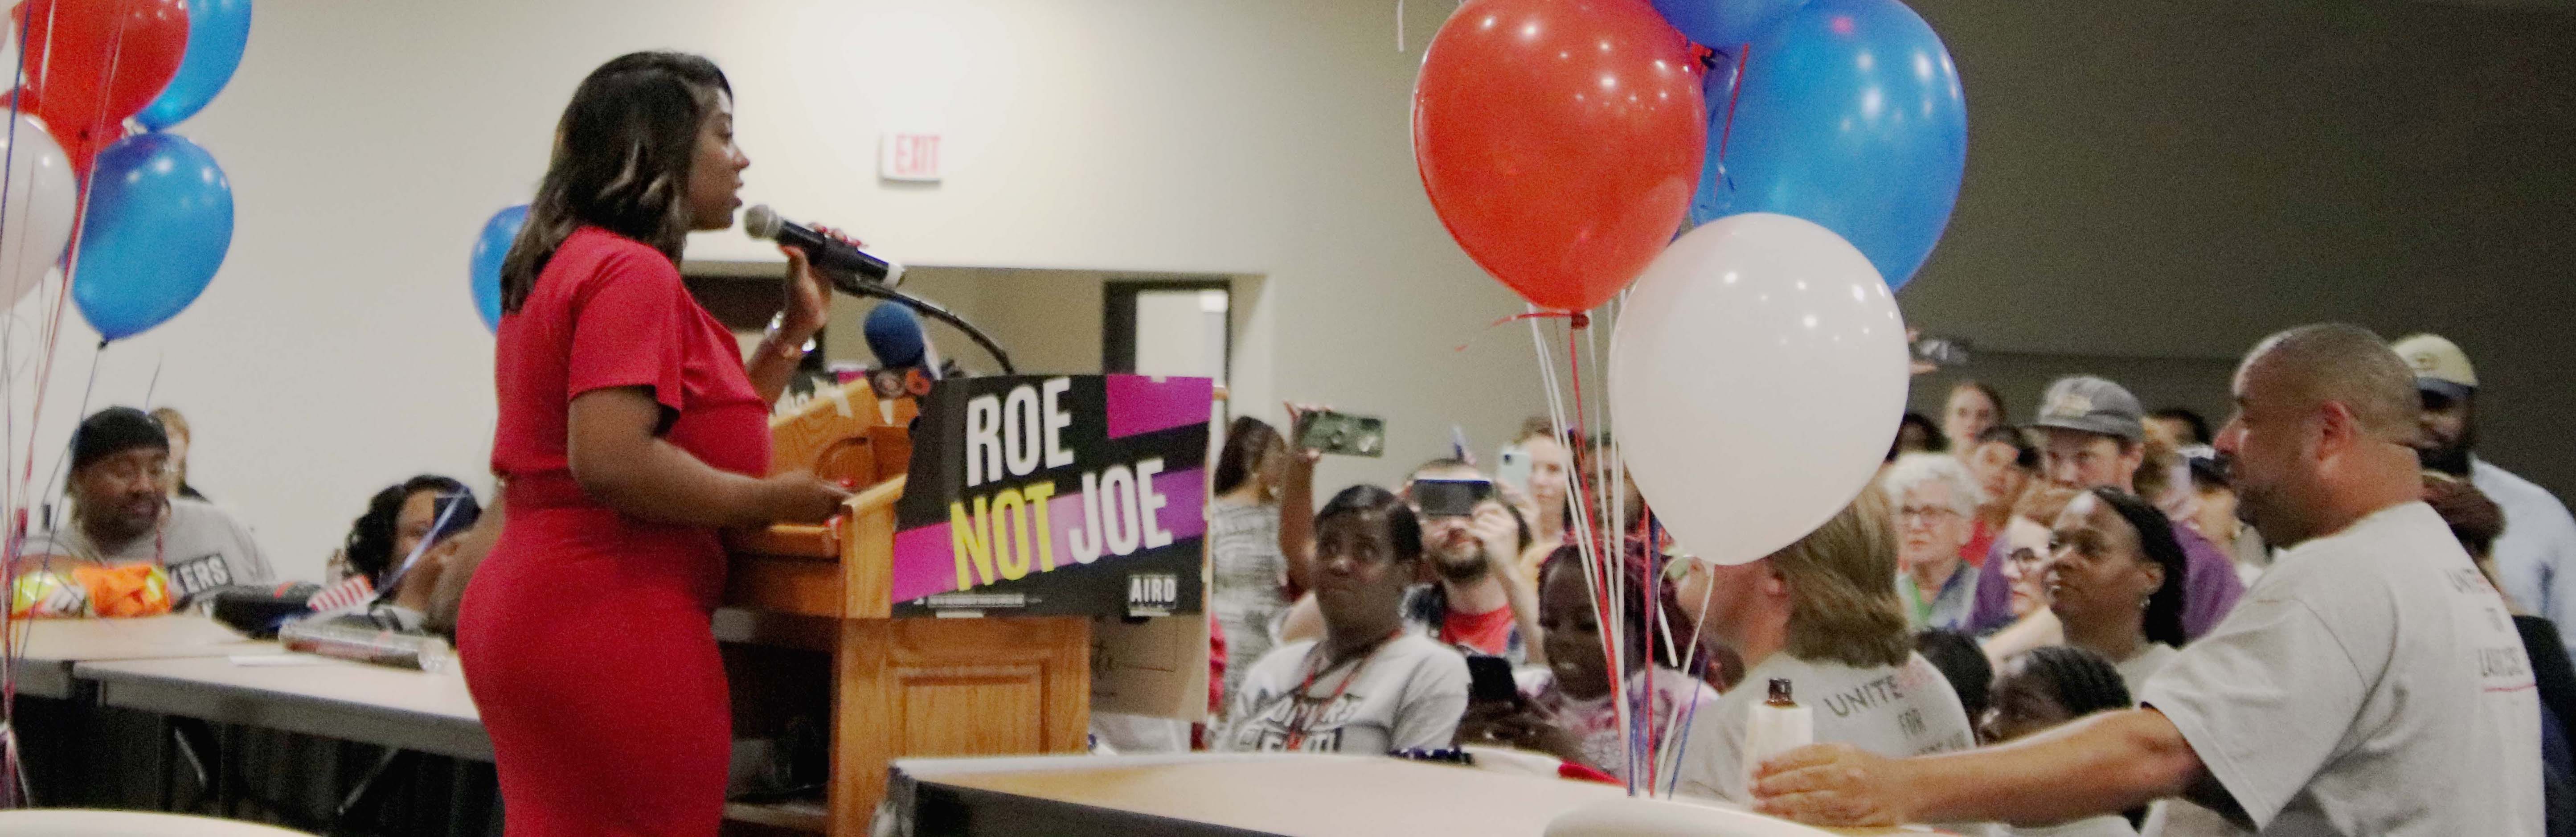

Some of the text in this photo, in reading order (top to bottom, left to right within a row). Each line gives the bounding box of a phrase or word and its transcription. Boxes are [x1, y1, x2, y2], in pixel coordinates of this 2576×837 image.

[895, 135, 941, 176] EXIT
[966, 377, 1074, 488] ROE
[950, 457, 1173, 592] NOT JOE
[1129, 578, 1175, 602] AIRD
[1823, 674, 1905, 718] UNITE
